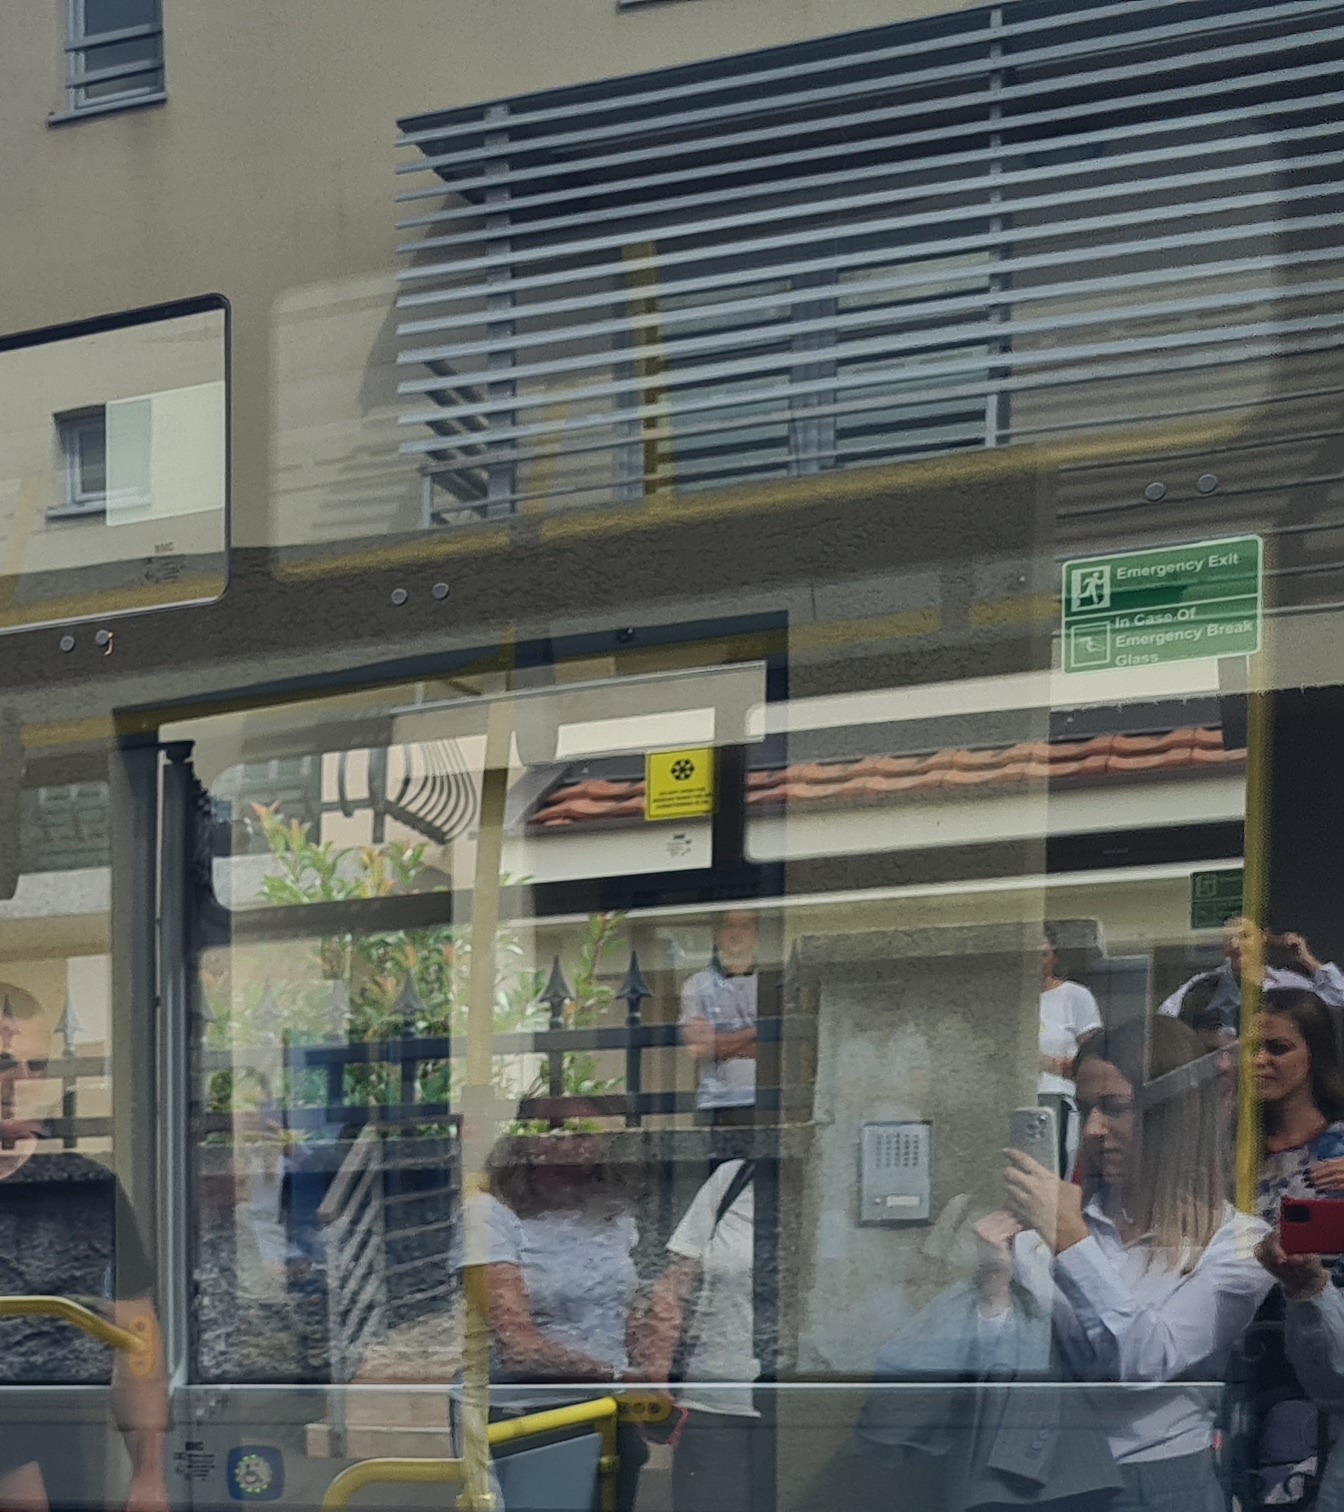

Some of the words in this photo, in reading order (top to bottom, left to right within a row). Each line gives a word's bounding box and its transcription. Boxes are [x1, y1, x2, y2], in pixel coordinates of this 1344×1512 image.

[1116, 559, 1205, 580] Emergency
[1208, 552, 1240, 568] Exit
[1115, 616, 1131, 629] In
[1133, 612, 1173, 627] Case
[1177, 607, 1197, 621] Of
[1115, 628, 1204, 648] Emergency
[1207, 620, 1253, 637] Break
[1115, 653, 1160, 667] Glass
